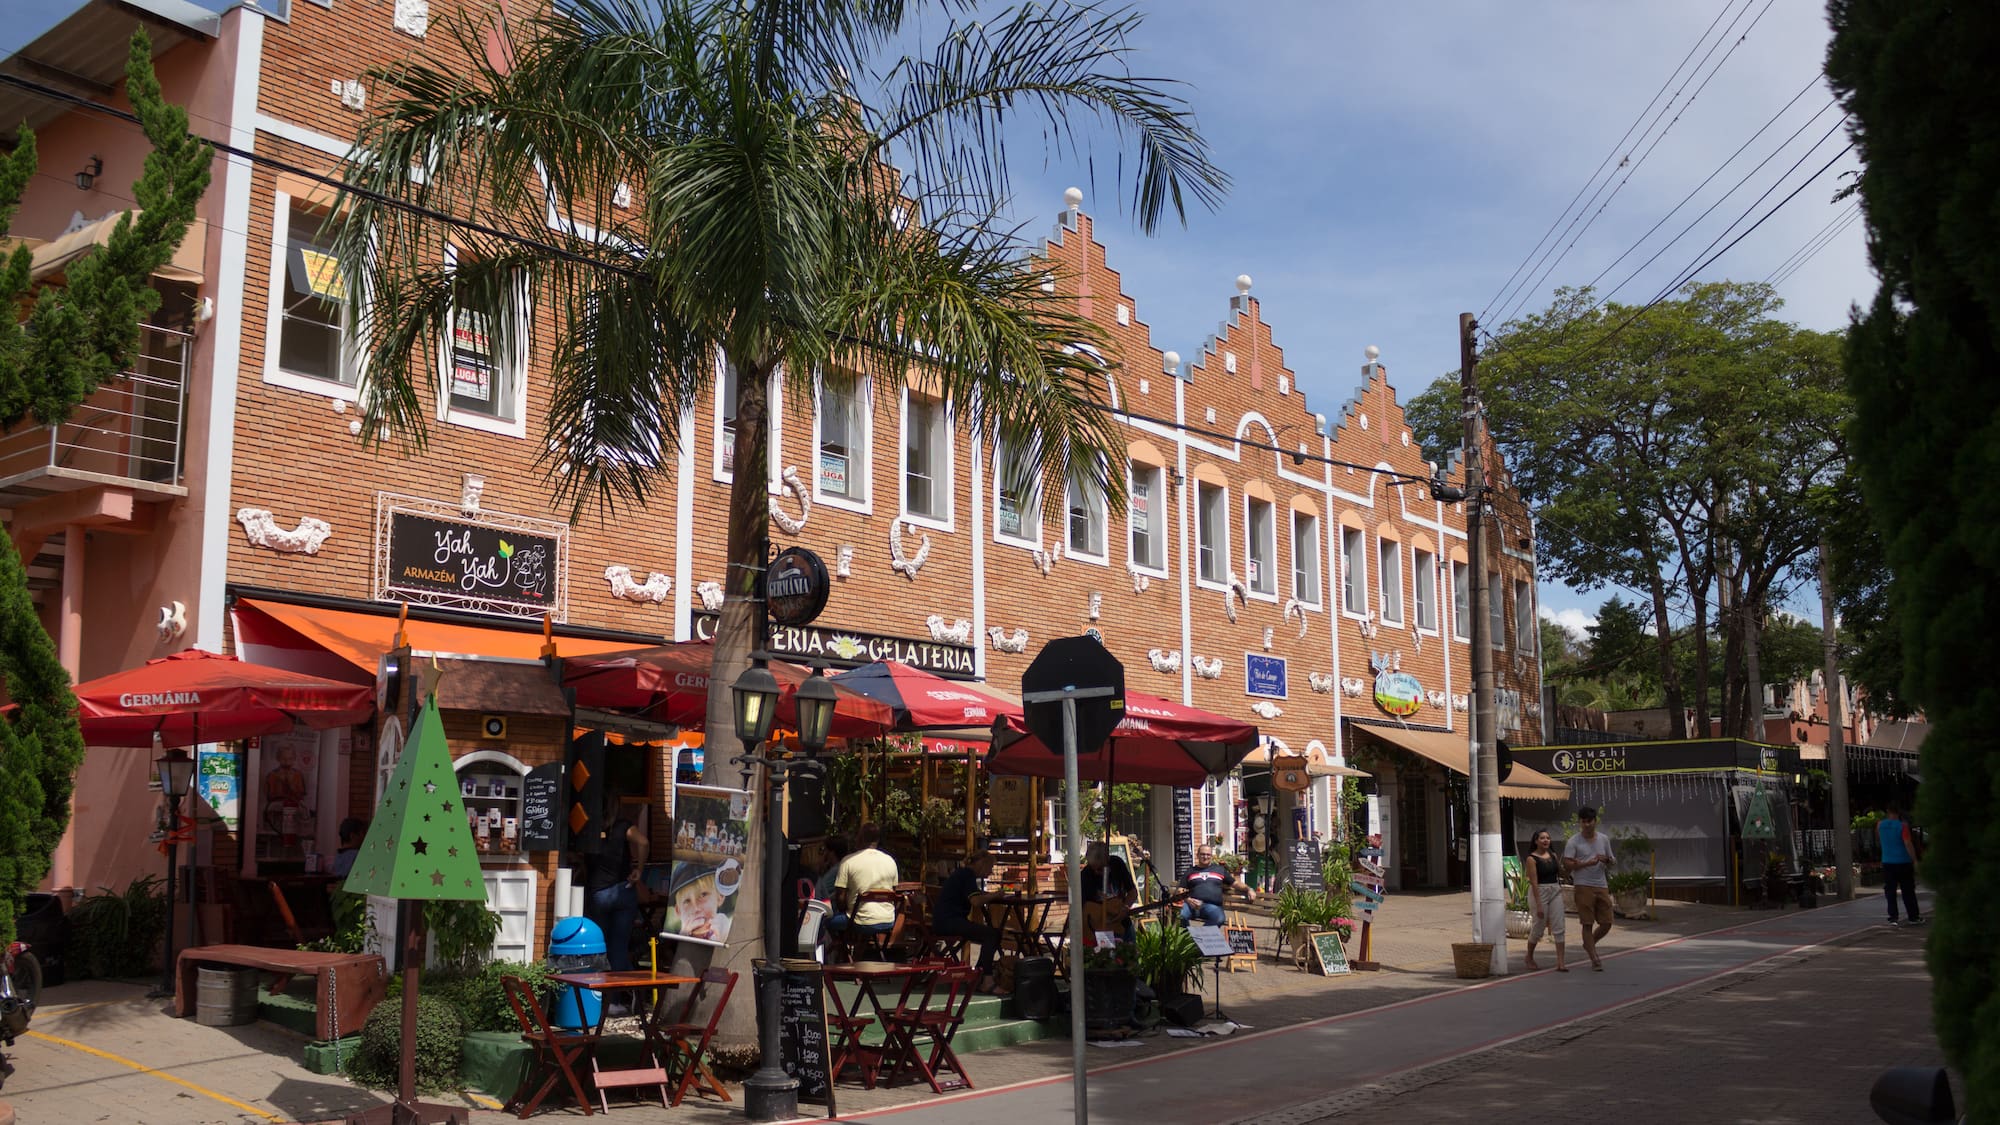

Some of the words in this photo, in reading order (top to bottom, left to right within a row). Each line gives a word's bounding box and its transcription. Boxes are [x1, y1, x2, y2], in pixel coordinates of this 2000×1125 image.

[434, 530, 474, 564] Yah
[403, 566, 456, 583] ARMAZÉM
[461, 556, 498, 591] Yah
[768, 576, 810, 597] GERMÂNIA
[868, 637, 974, 673] GELATERIA
[119, 691, 200, 706] GERMÂNIA
[1576, 747, 1626, 758] sushi
[1577, 758, 1626, 772] BLOEM
